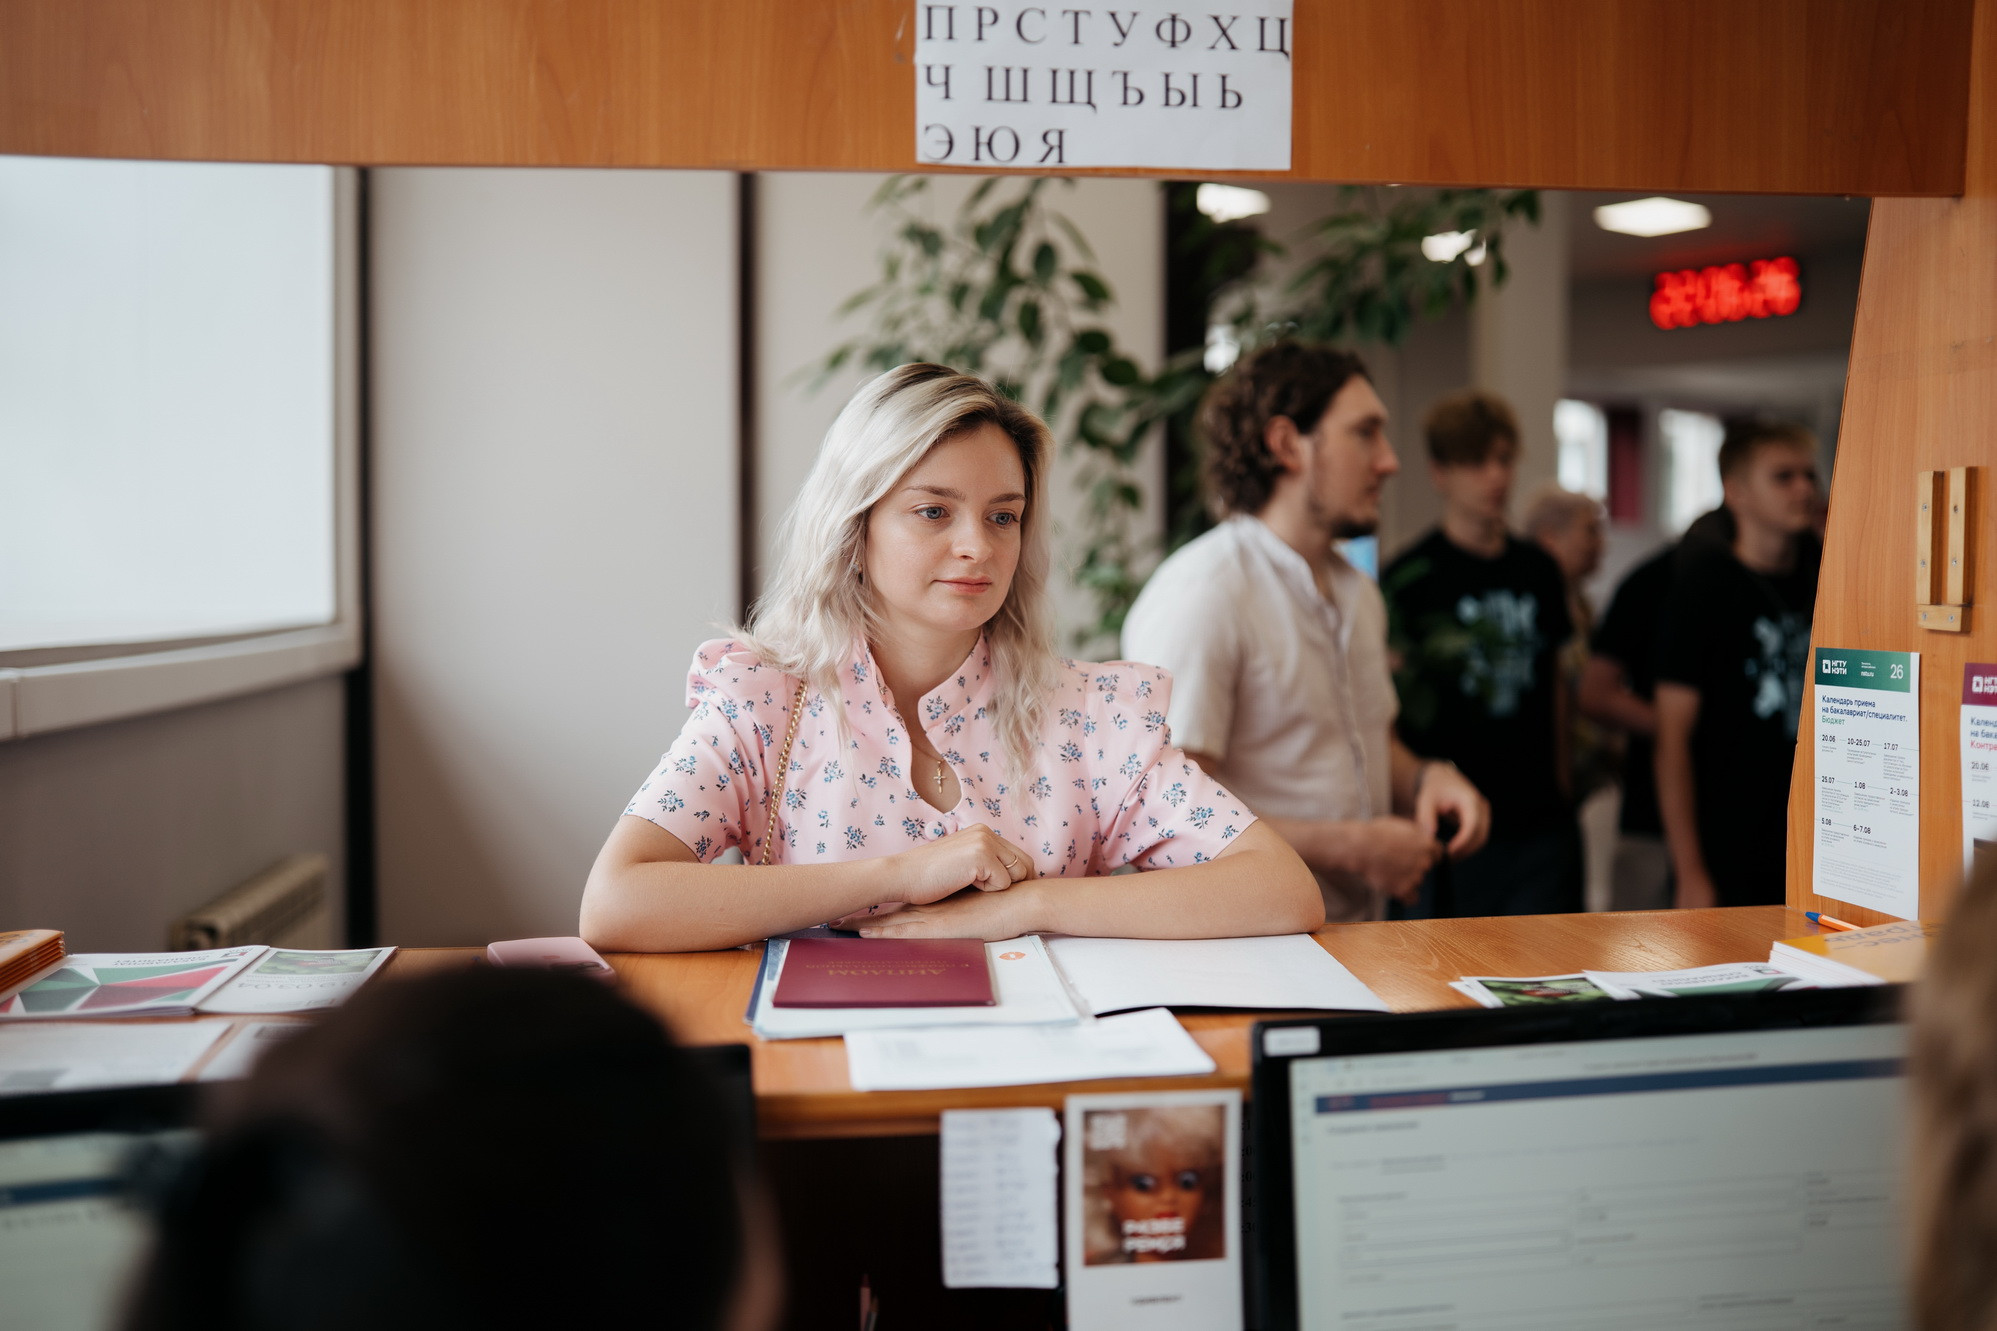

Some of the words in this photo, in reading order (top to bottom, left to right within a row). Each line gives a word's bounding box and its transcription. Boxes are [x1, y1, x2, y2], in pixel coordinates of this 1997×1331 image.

[923, 4, 955, 41] П
[973, 6, 999, 42] Р
[1016, 8, 1047, 44] С
[1062, 9, 1091, 45] Т
[1107, 11, 1140, 47] У
[1155, 12, 1192, 49] Ф
[1207, 14, 1241, 51] Х
[1256, 16, 1290, 60] Ц
[924, 64, 953, 100] Ч
[983, 66, 1031, 104] Ш
[1048, 68, 1098, 114] Щ
[1111, 70, 1145, 107] Ъ
[1160, 71, 1204, 109] Ы
[1216, 73, 1244, 110] Ь
[924, 123, 954, 161] Э
[971, 125, 1021, 163] Ю
[1038, 128, 1068, 165] Я
[1831, 660, 1848, 668] НГТУ
[1831, 667, 1848, 675] НЭТИ
[1889, 664, 1904, 680] 26
[1822, 695, 1854, 706] Календарь
[1854, 699, 1876, 709] приема
[1821, 706, 1829, 714] на
[1821, 715, 1846, 726] Бюджет
[1822, 734, 1836, 743] 20.06
[1970, 730, 1979, 738] на
[1883, 742, 1899, 751] 17.07
[1821, 775, 1835, 784] 25.07
[1854, 781, 1866, 790] 1.08
[1821, 817, 1832, 826] 5.08
